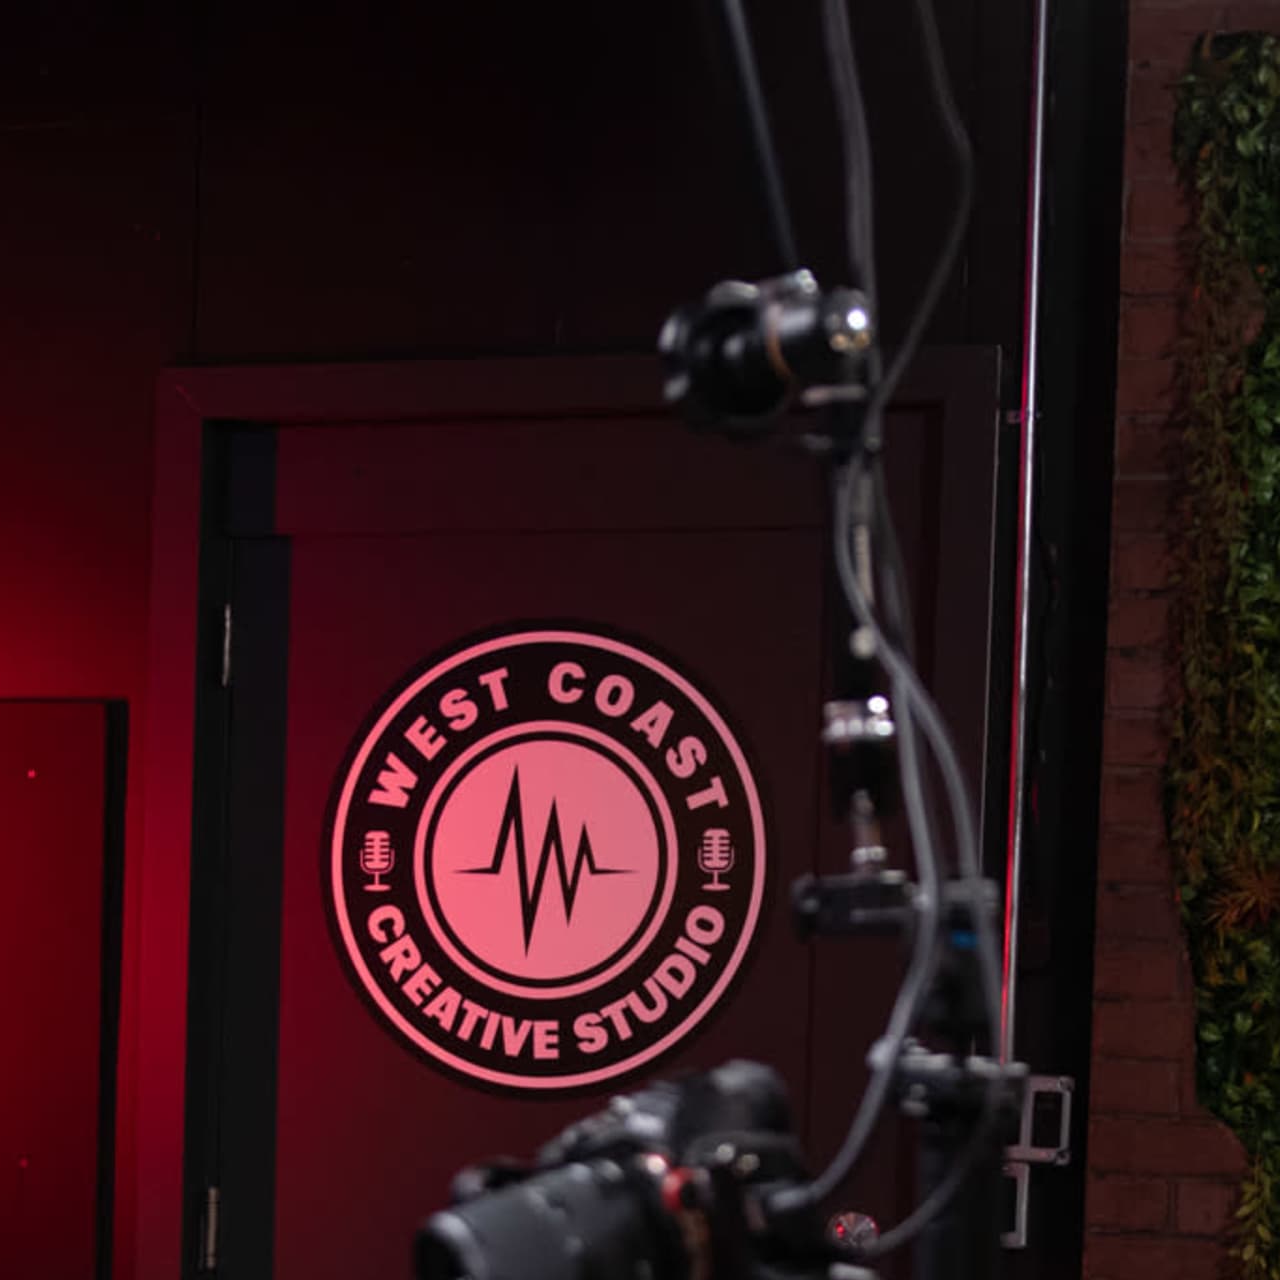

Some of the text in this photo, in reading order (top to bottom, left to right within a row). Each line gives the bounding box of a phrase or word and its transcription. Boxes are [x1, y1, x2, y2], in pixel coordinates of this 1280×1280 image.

[367, 660, 729, 811] WEST COAST
[366, 904, 727, 1060] CREATIVE STUDIO
